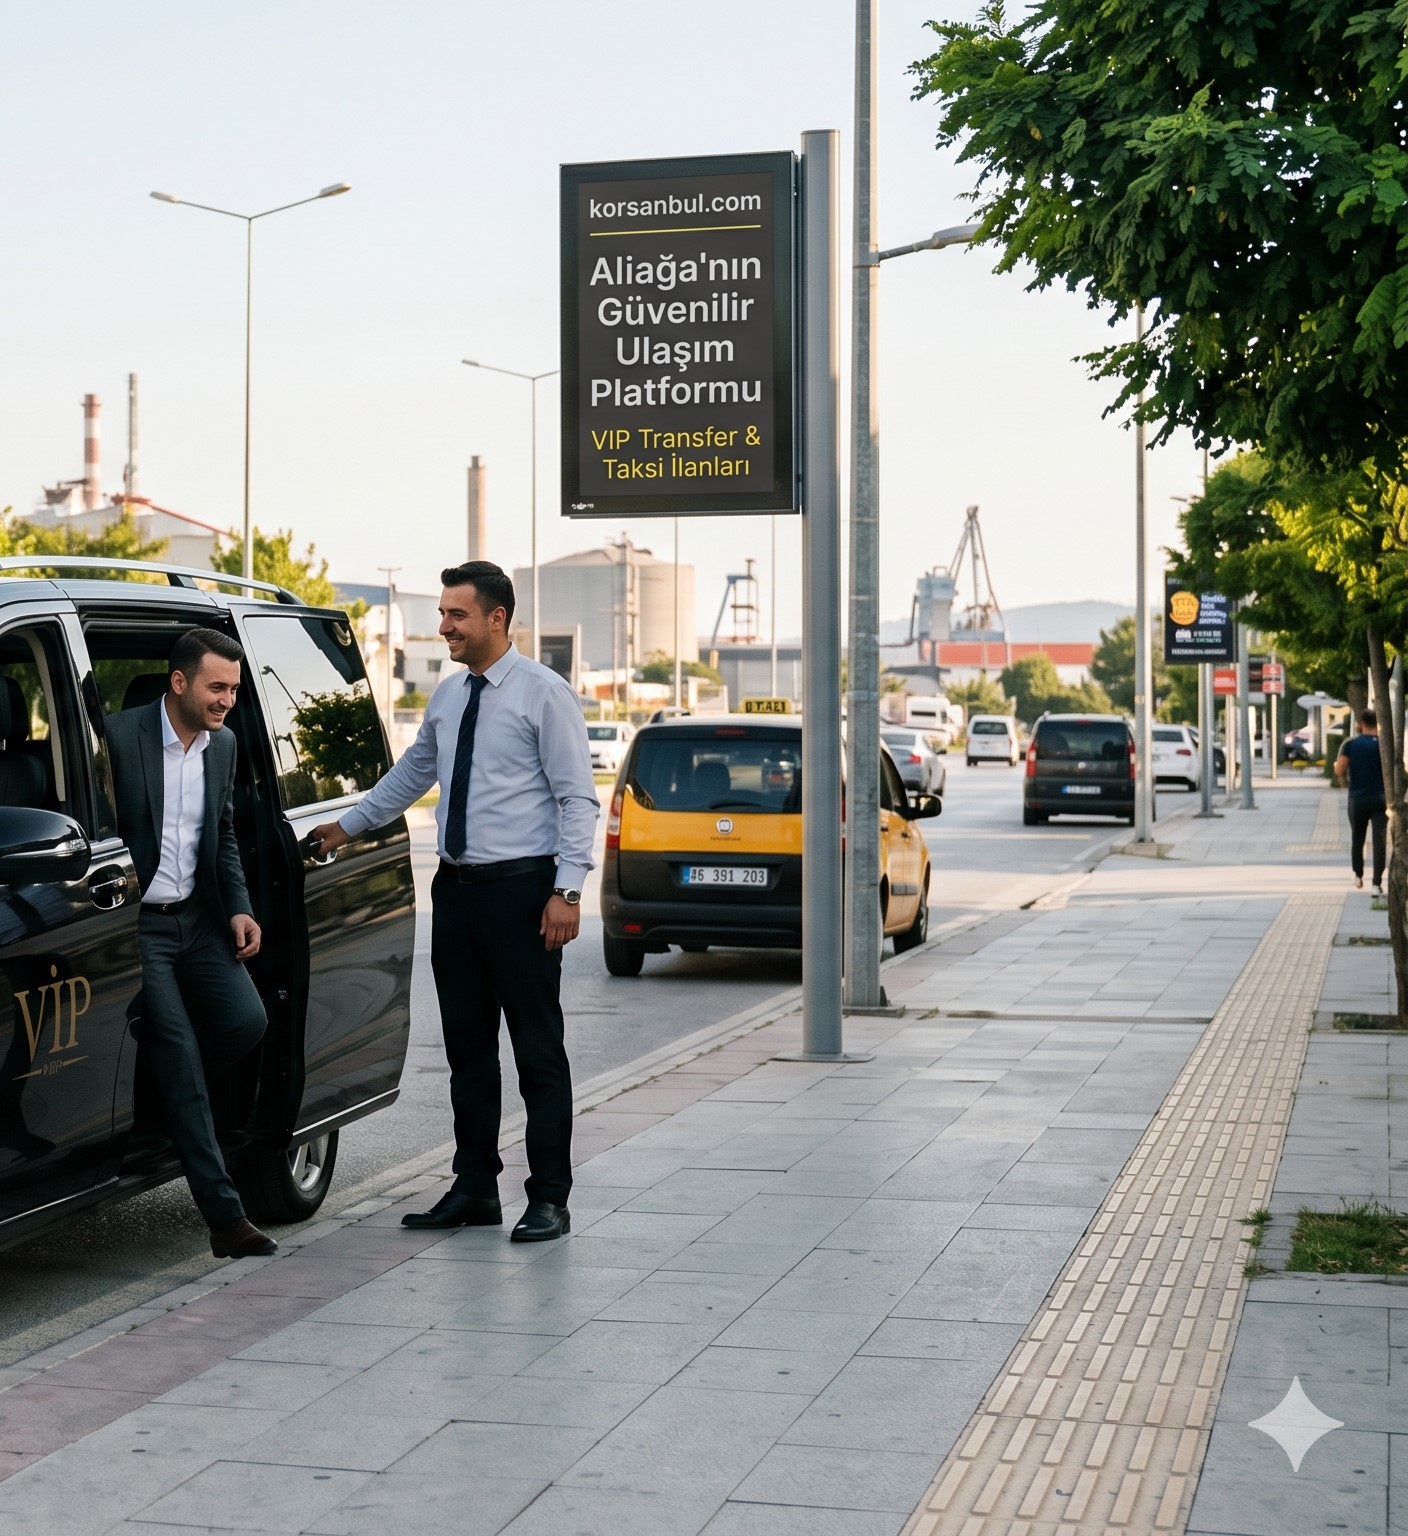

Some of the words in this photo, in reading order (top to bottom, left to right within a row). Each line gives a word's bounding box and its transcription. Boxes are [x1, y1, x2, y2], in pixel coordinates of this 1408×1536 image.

[590, 194, 761, 218] korsanbul.com
[589, 253, 761, 291] Aliağa'nın
[597, 292, 754, 326] Güvenilir
[616, 336, 734, 372] Ulaşım
[591, 376, 762, 407] Platformu
[592, 430, 630, 450] VIP
[638, 426, 738, 449] Transfer
[745, 425, 761, 446] &
[602, 458, 663, 479] Taksi
[671, 453, 750, 478] İlanları
[712, 869, 734, 882] 391
[742, 870, 765, 883] 203
